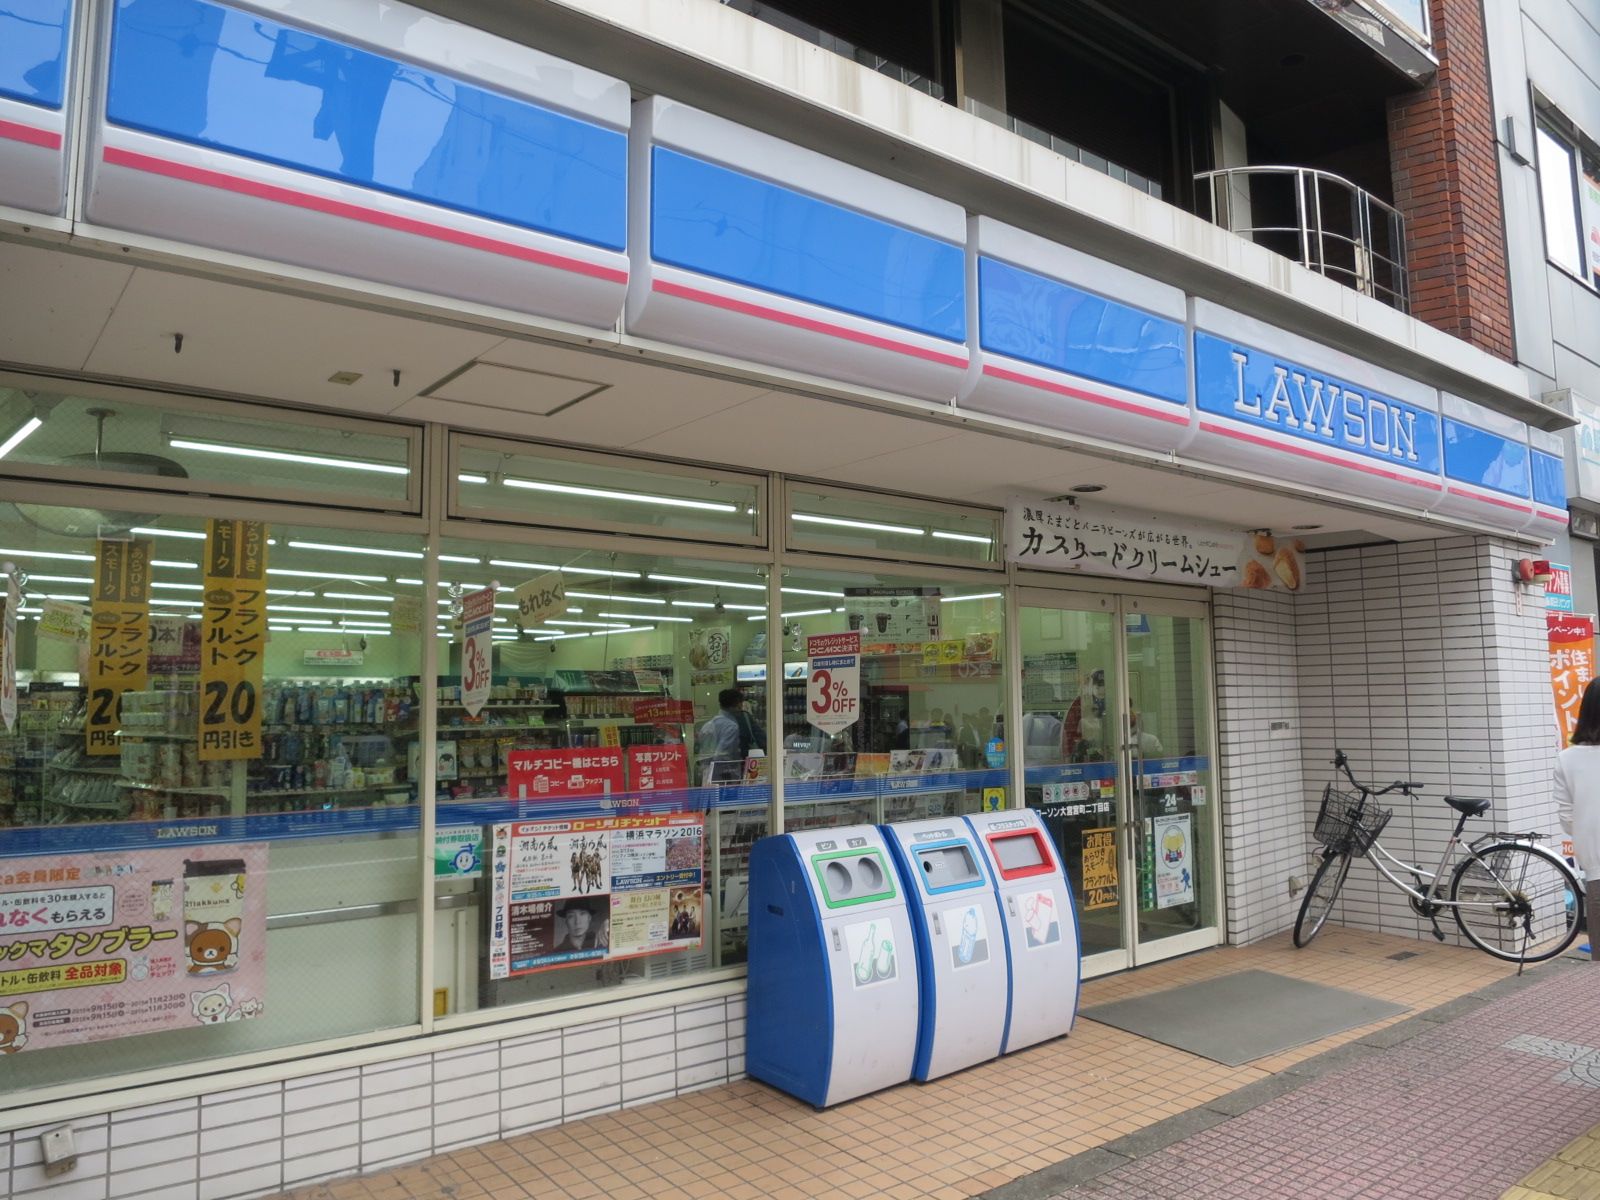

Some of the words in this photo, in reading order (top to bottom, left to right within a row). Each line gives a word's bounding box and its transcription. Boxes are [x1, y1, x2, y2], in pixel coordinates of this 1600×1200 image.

[1231, 350, 1418, 462] LAWSON
[1019, 526, 1237, 578] カスタードクリームシュー
[206, 606, 232, 666] フルト
[234, 588, 260, 666] フランク
[94, 626, 118, 676] フルト
[119, 611, 144, 676] フランク
[475, 669, 490, 690] OFF
[203, 680, 256, 725] 20
[832, 698, 856, 713] OFF
[202, 730, 255, 750] 円引き
[513, 756, 619, 772] マルチコピー機はこちら
[635, 751, 682, 764] 写真プリント
[1164, 794, 1177, 807] 24
[156, 825, 218, 839] LAWSON
[64, 962, 123, 982] 全品対象
